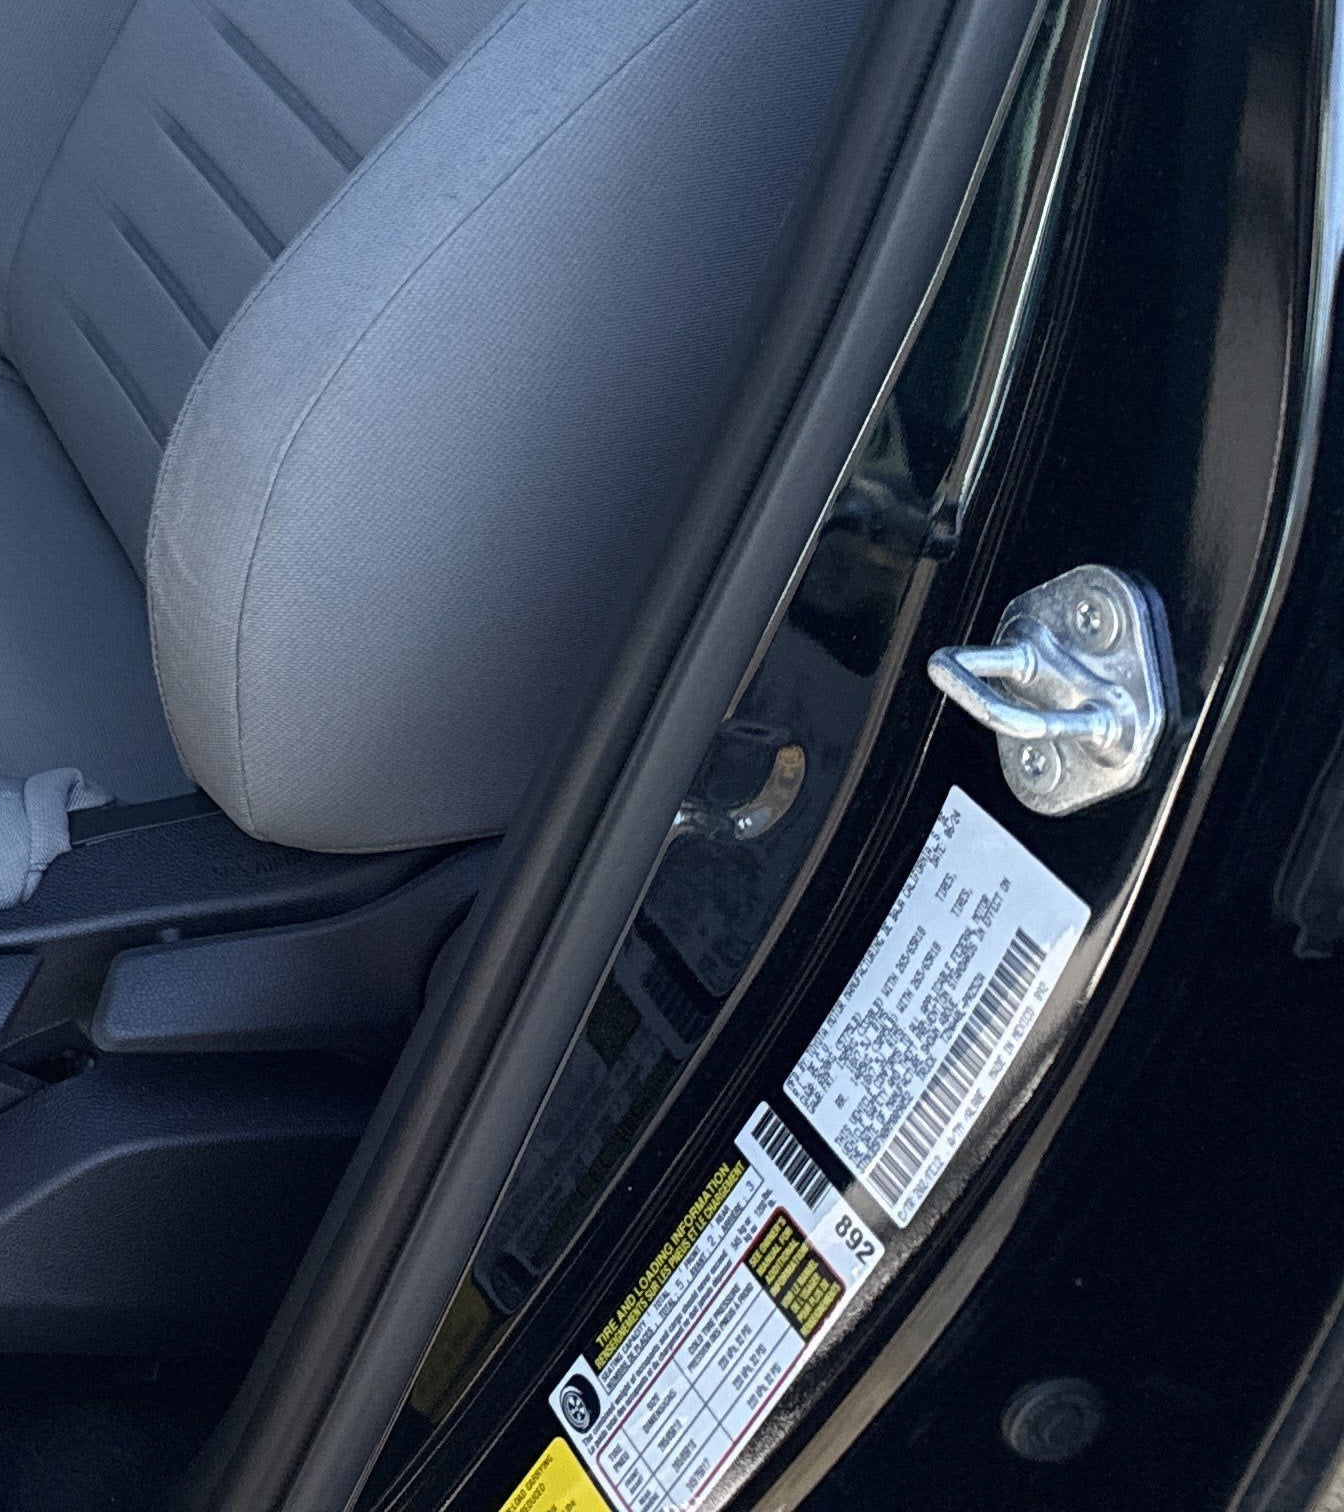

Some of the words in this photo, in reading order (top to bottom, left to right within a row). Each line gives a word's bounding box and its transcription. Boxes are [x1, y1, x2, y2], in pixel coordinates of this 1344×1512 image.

[595, 1318, 618, 1346] TIRE
[616, 1293, 635, 1321] AND
[634, 1242, 673, 1296] LOADING
[671, 1163, 728, 1244] INFORMATION
[835, 1215, 874, 1264] 892
[644, 1280, 660, 1301] SUR
[656, 1264, 671, 1284] LES
